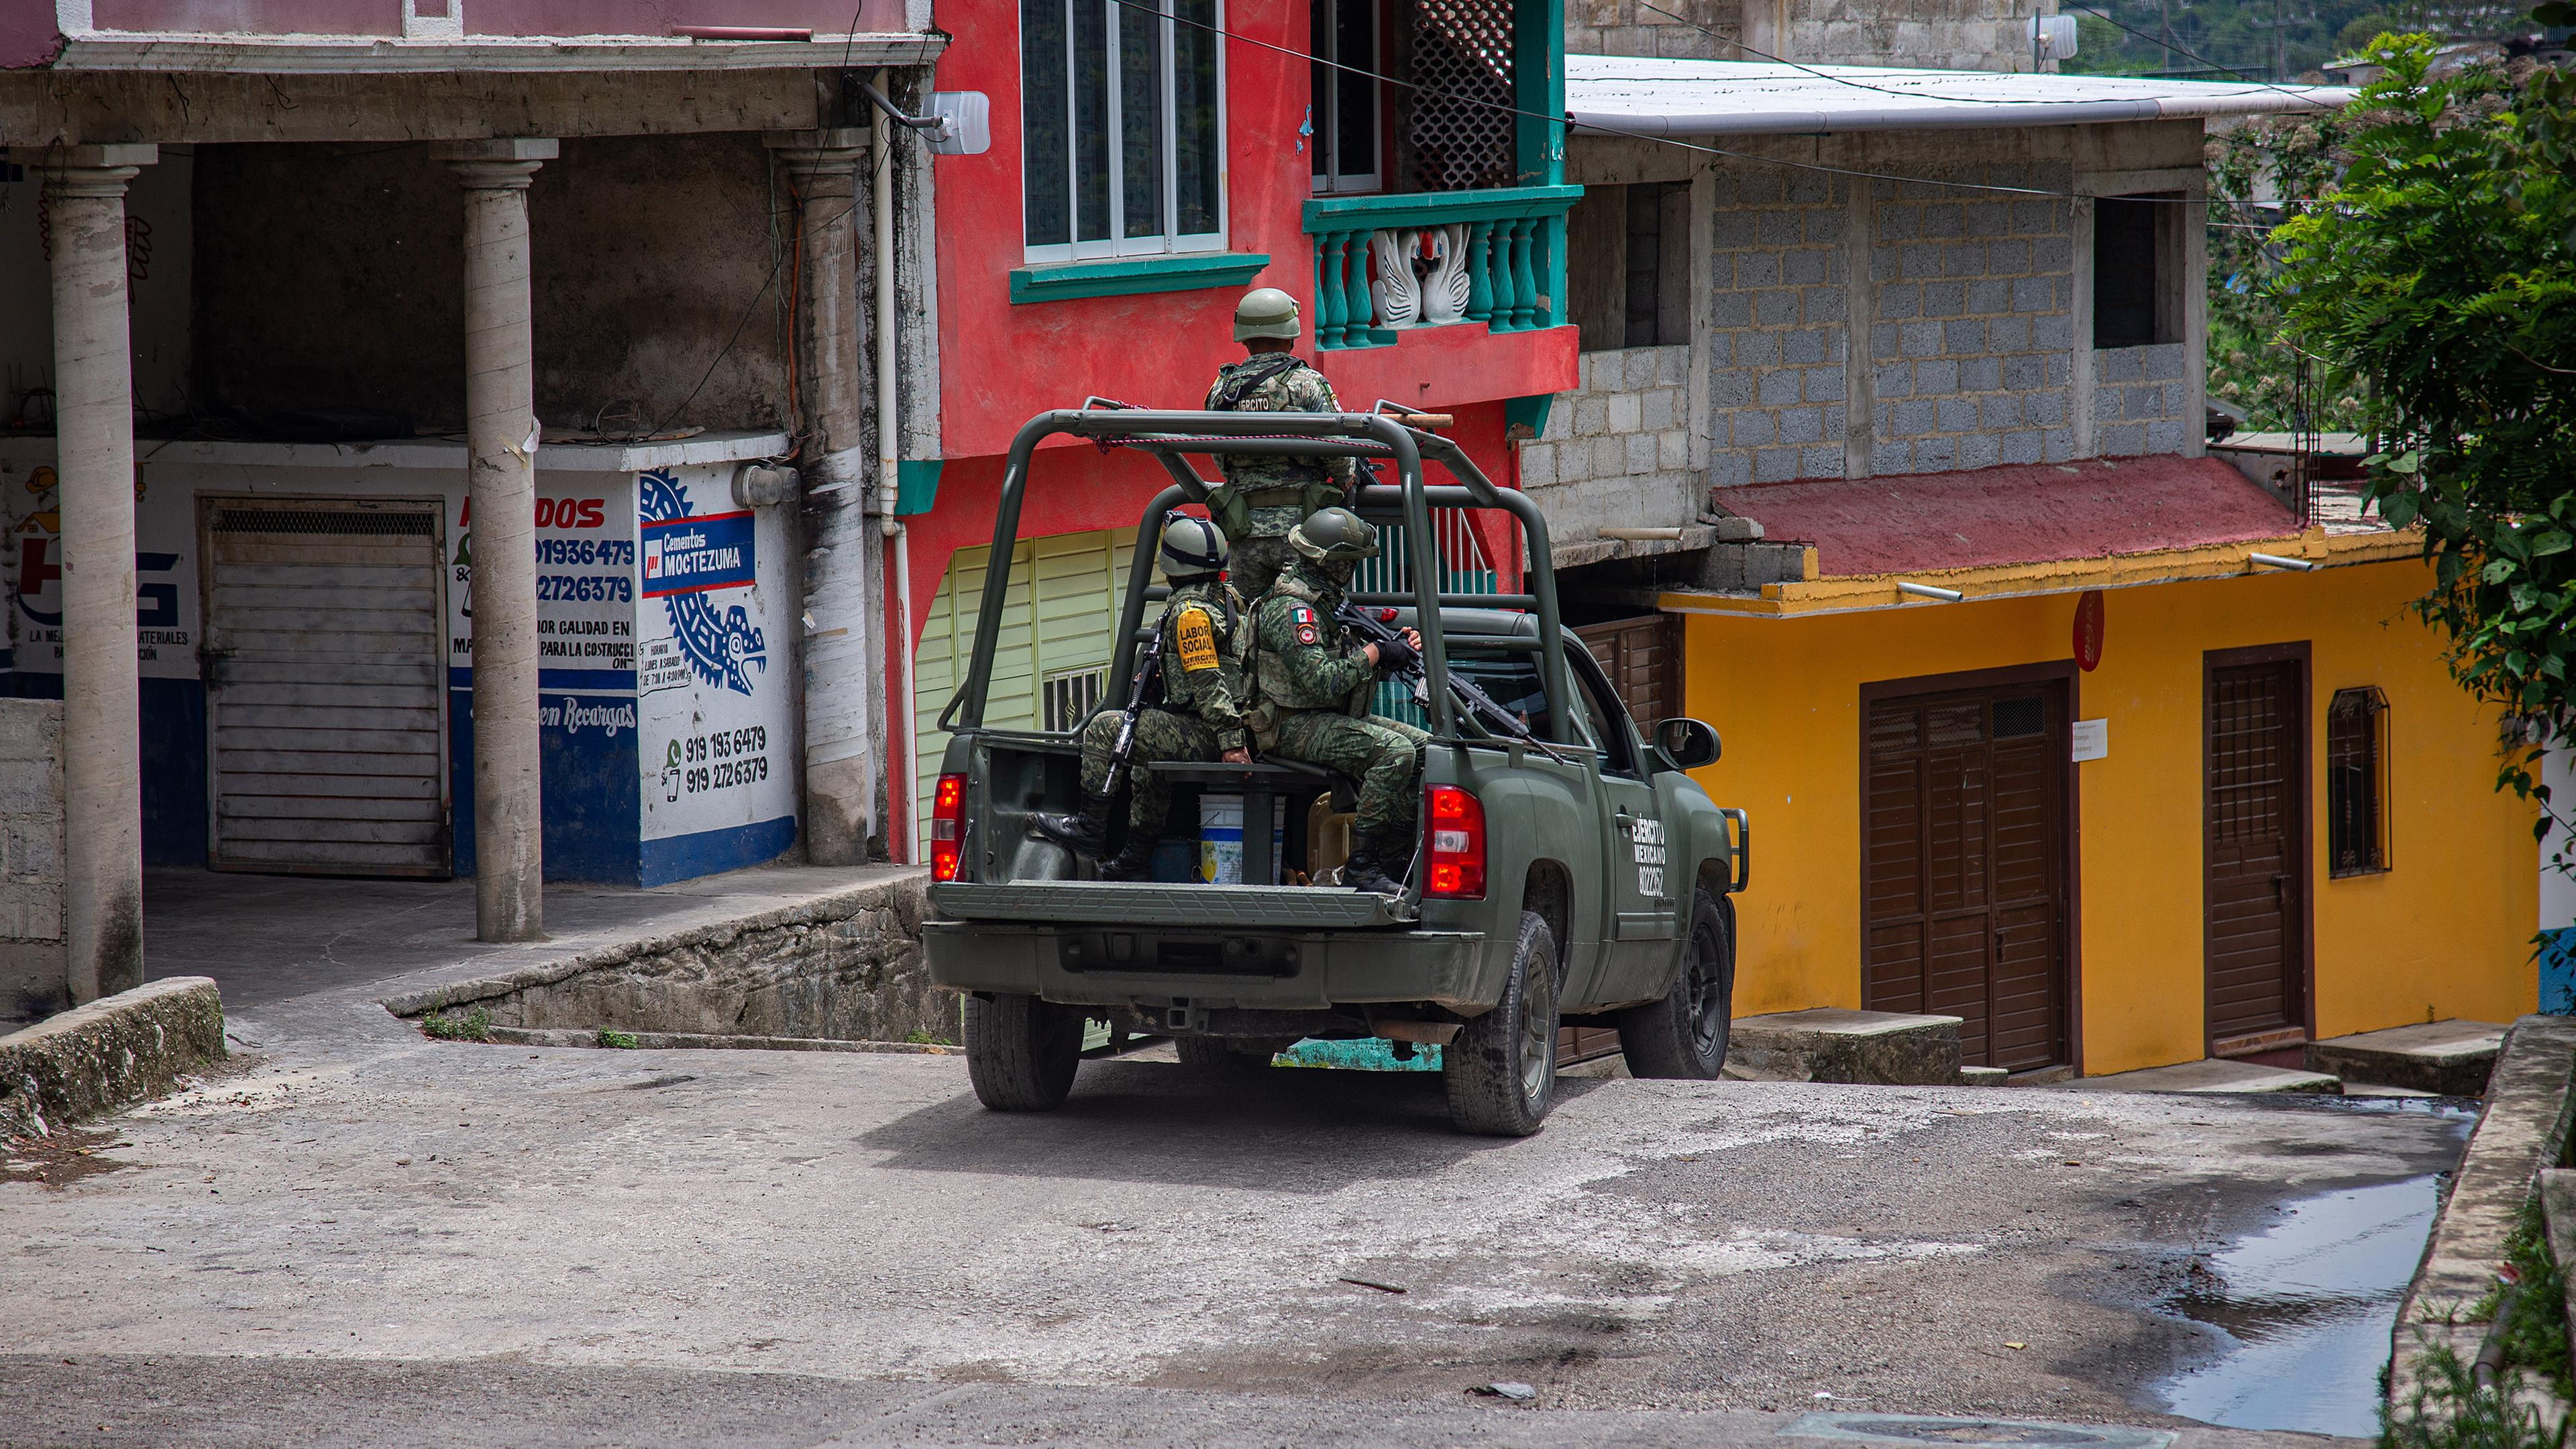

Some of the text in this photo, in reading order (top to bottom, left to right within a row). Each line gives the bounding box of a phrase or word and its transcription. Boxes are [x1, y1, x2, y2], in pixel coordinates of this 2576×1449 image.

[664, 527, 706, 553] Cementos
[665, 547, 741, 577] MOCTEZUMA
[536, 575, 633, 603] 2726379
[537, 620, 629, 636] JOR CALIDAD EN
[1179, 625, 1210, 641] LABOR
[30, 631, 188, 645] LA MEJ ATERIALES
[1182, 638, 1212, 654] SOCIAL
[139, 645, 157, 661] CIÓN
[541, 641, 567, 656] PARA
[569, 642, 582, 657] LA
[650, 643, 668, 656] HORARIO
[645, 659, 657, 672] LUNES
[643, 674, 649, 686] DE
[539, 697, 636, 737] en Recargas
[686, 725, 766, 763] 919 193 6479
[686, 767, 709, 794] 919
[1632, 812, 1665, 845] EJÉRCITO
[1634, 844, 1666, 865] MEXICANO
[1639, 865, 1664, 898] 8022352
